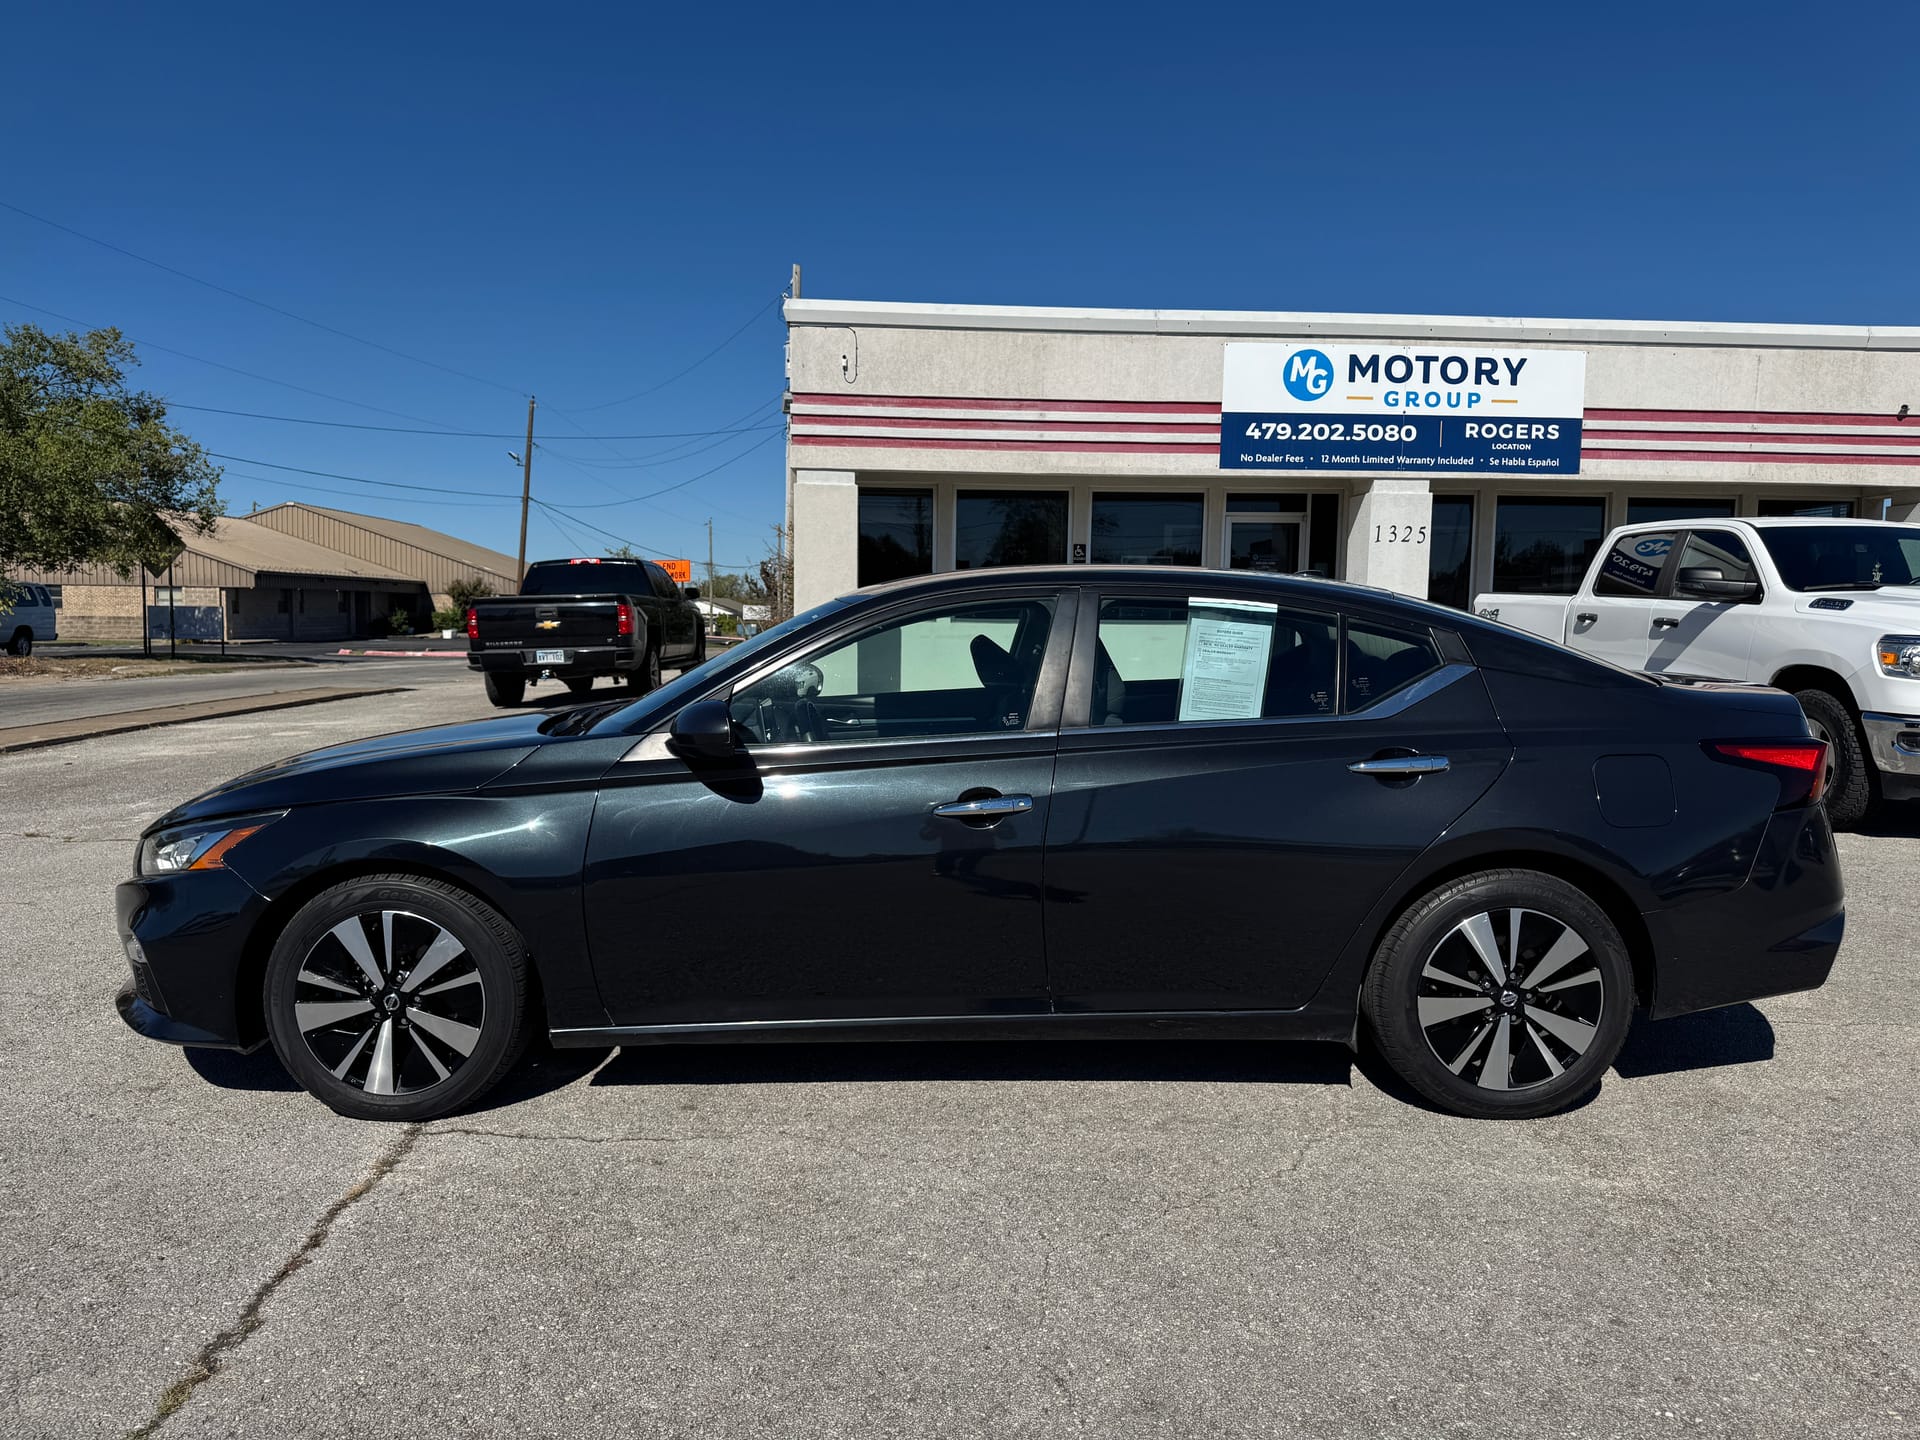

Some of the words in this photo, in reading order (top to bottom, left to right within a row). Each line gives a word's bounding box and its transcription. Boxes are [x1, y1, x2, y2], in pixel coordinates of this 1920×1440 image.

[1290, 355, 1328, 395] MG
[1348, 354, 1528, 386] MOTORY
[1383, 390, 1482, 409] GROUP
[1245, 422, 1417, 442] 479.202.5080
[1465, 422, 1560, 440] ROGERS
[1491, 443, 1532, 451] LOCATION
[1240, 453, 1253, 462] No
[1255, 453, 1284, 463] Dealer
[1285, 454, 1305, 463] Fees
[1321, 454, 1330, 463] 12
[1331, 454, 1360, 464] Month
[1362, 455, 1395, 464] Limited
[1396, 456, 1436, 467] Warranty
[1437, 456, 1474, 466] Included
[1489, 457, 1500, 466] Se
[1501, 457, 1526, 467] Habla
[1528, 457, 1560, 468] Español
[1374, 524, 1427, 544] 1325
[662, 562, 676, 570] END
[1479, 608, 1500, 621] 4x4
